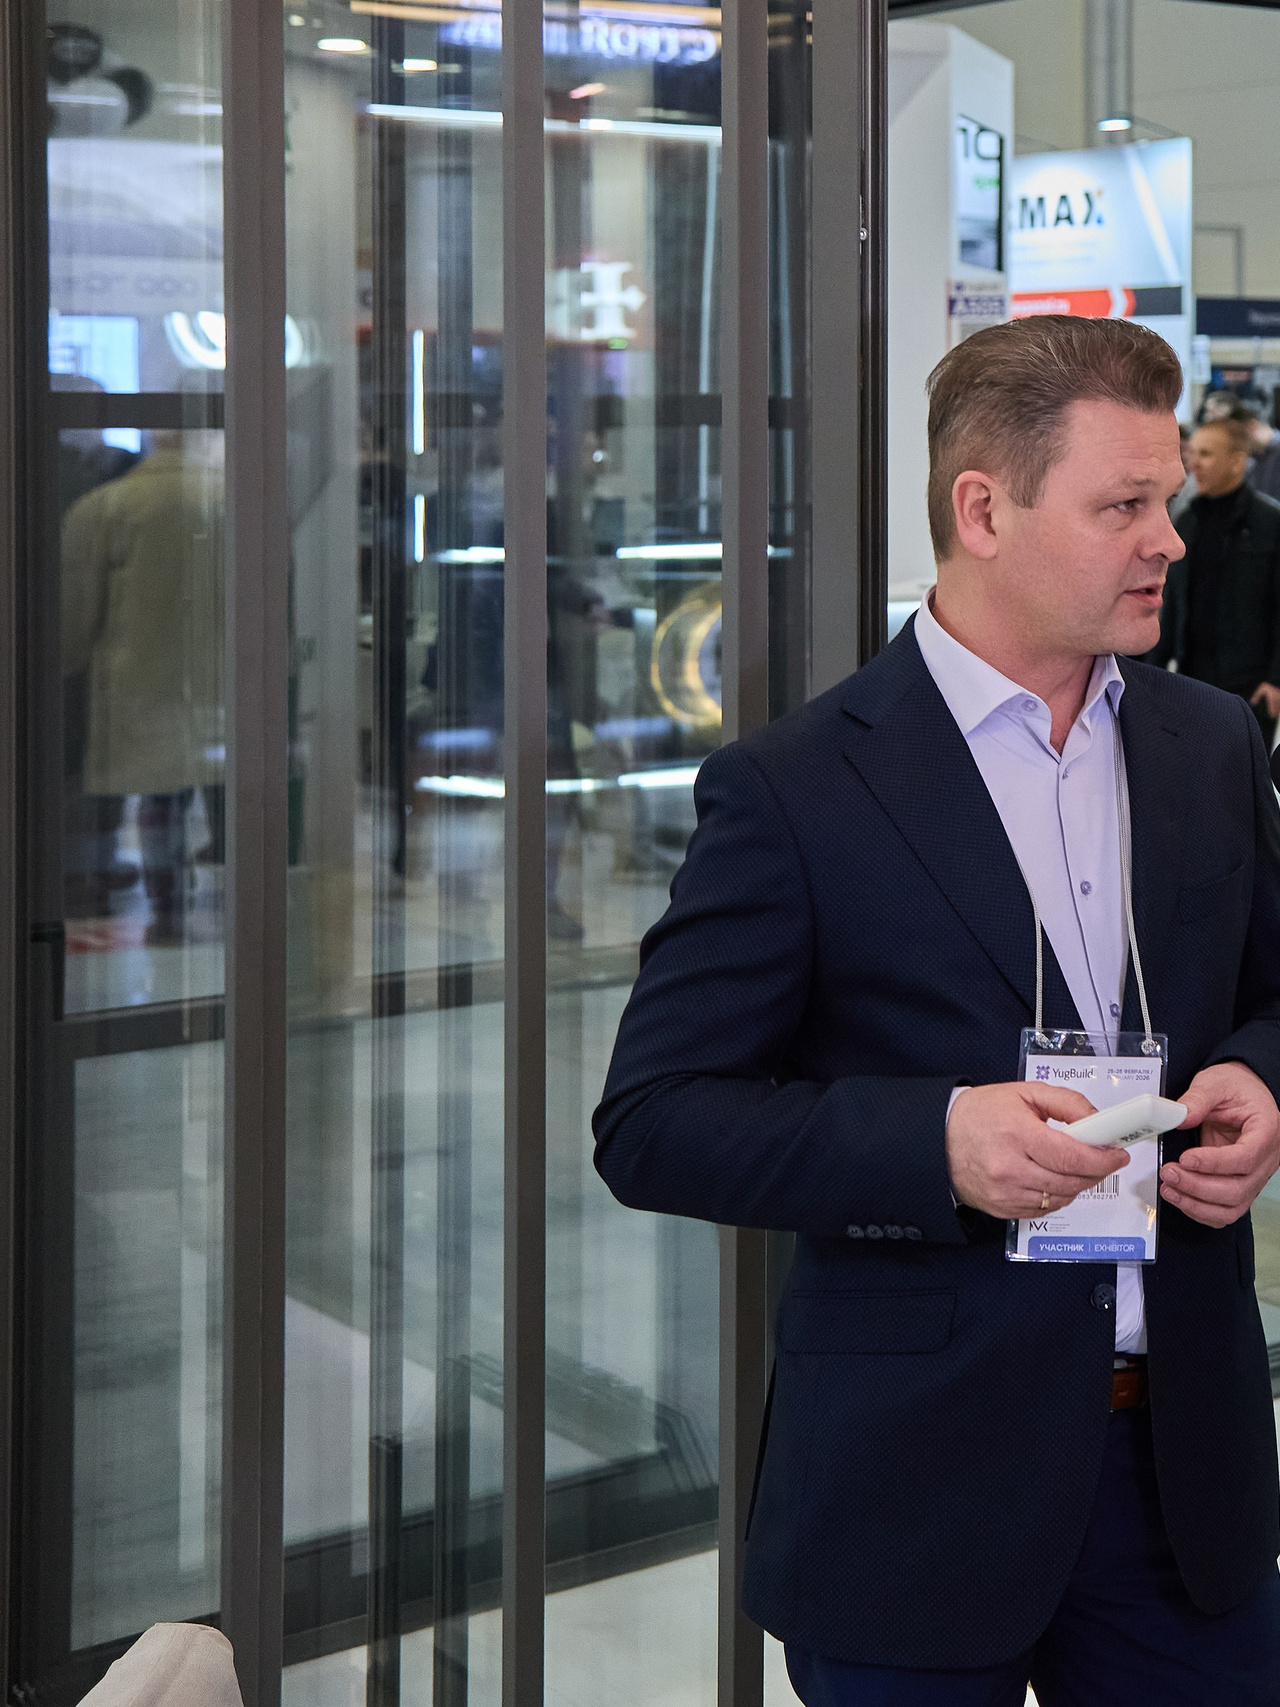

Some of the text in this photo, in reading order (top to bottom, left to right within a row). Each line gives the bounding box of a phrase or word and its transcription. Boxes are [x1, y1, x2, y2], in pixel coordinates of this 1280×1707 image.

[1008, 190, 1104, 230] MAX
[1053, 1068, 1094, 1080] YugBuild
[1040, 1244, 1135, 1252] УЧАСТНИК EXHIBITOR
